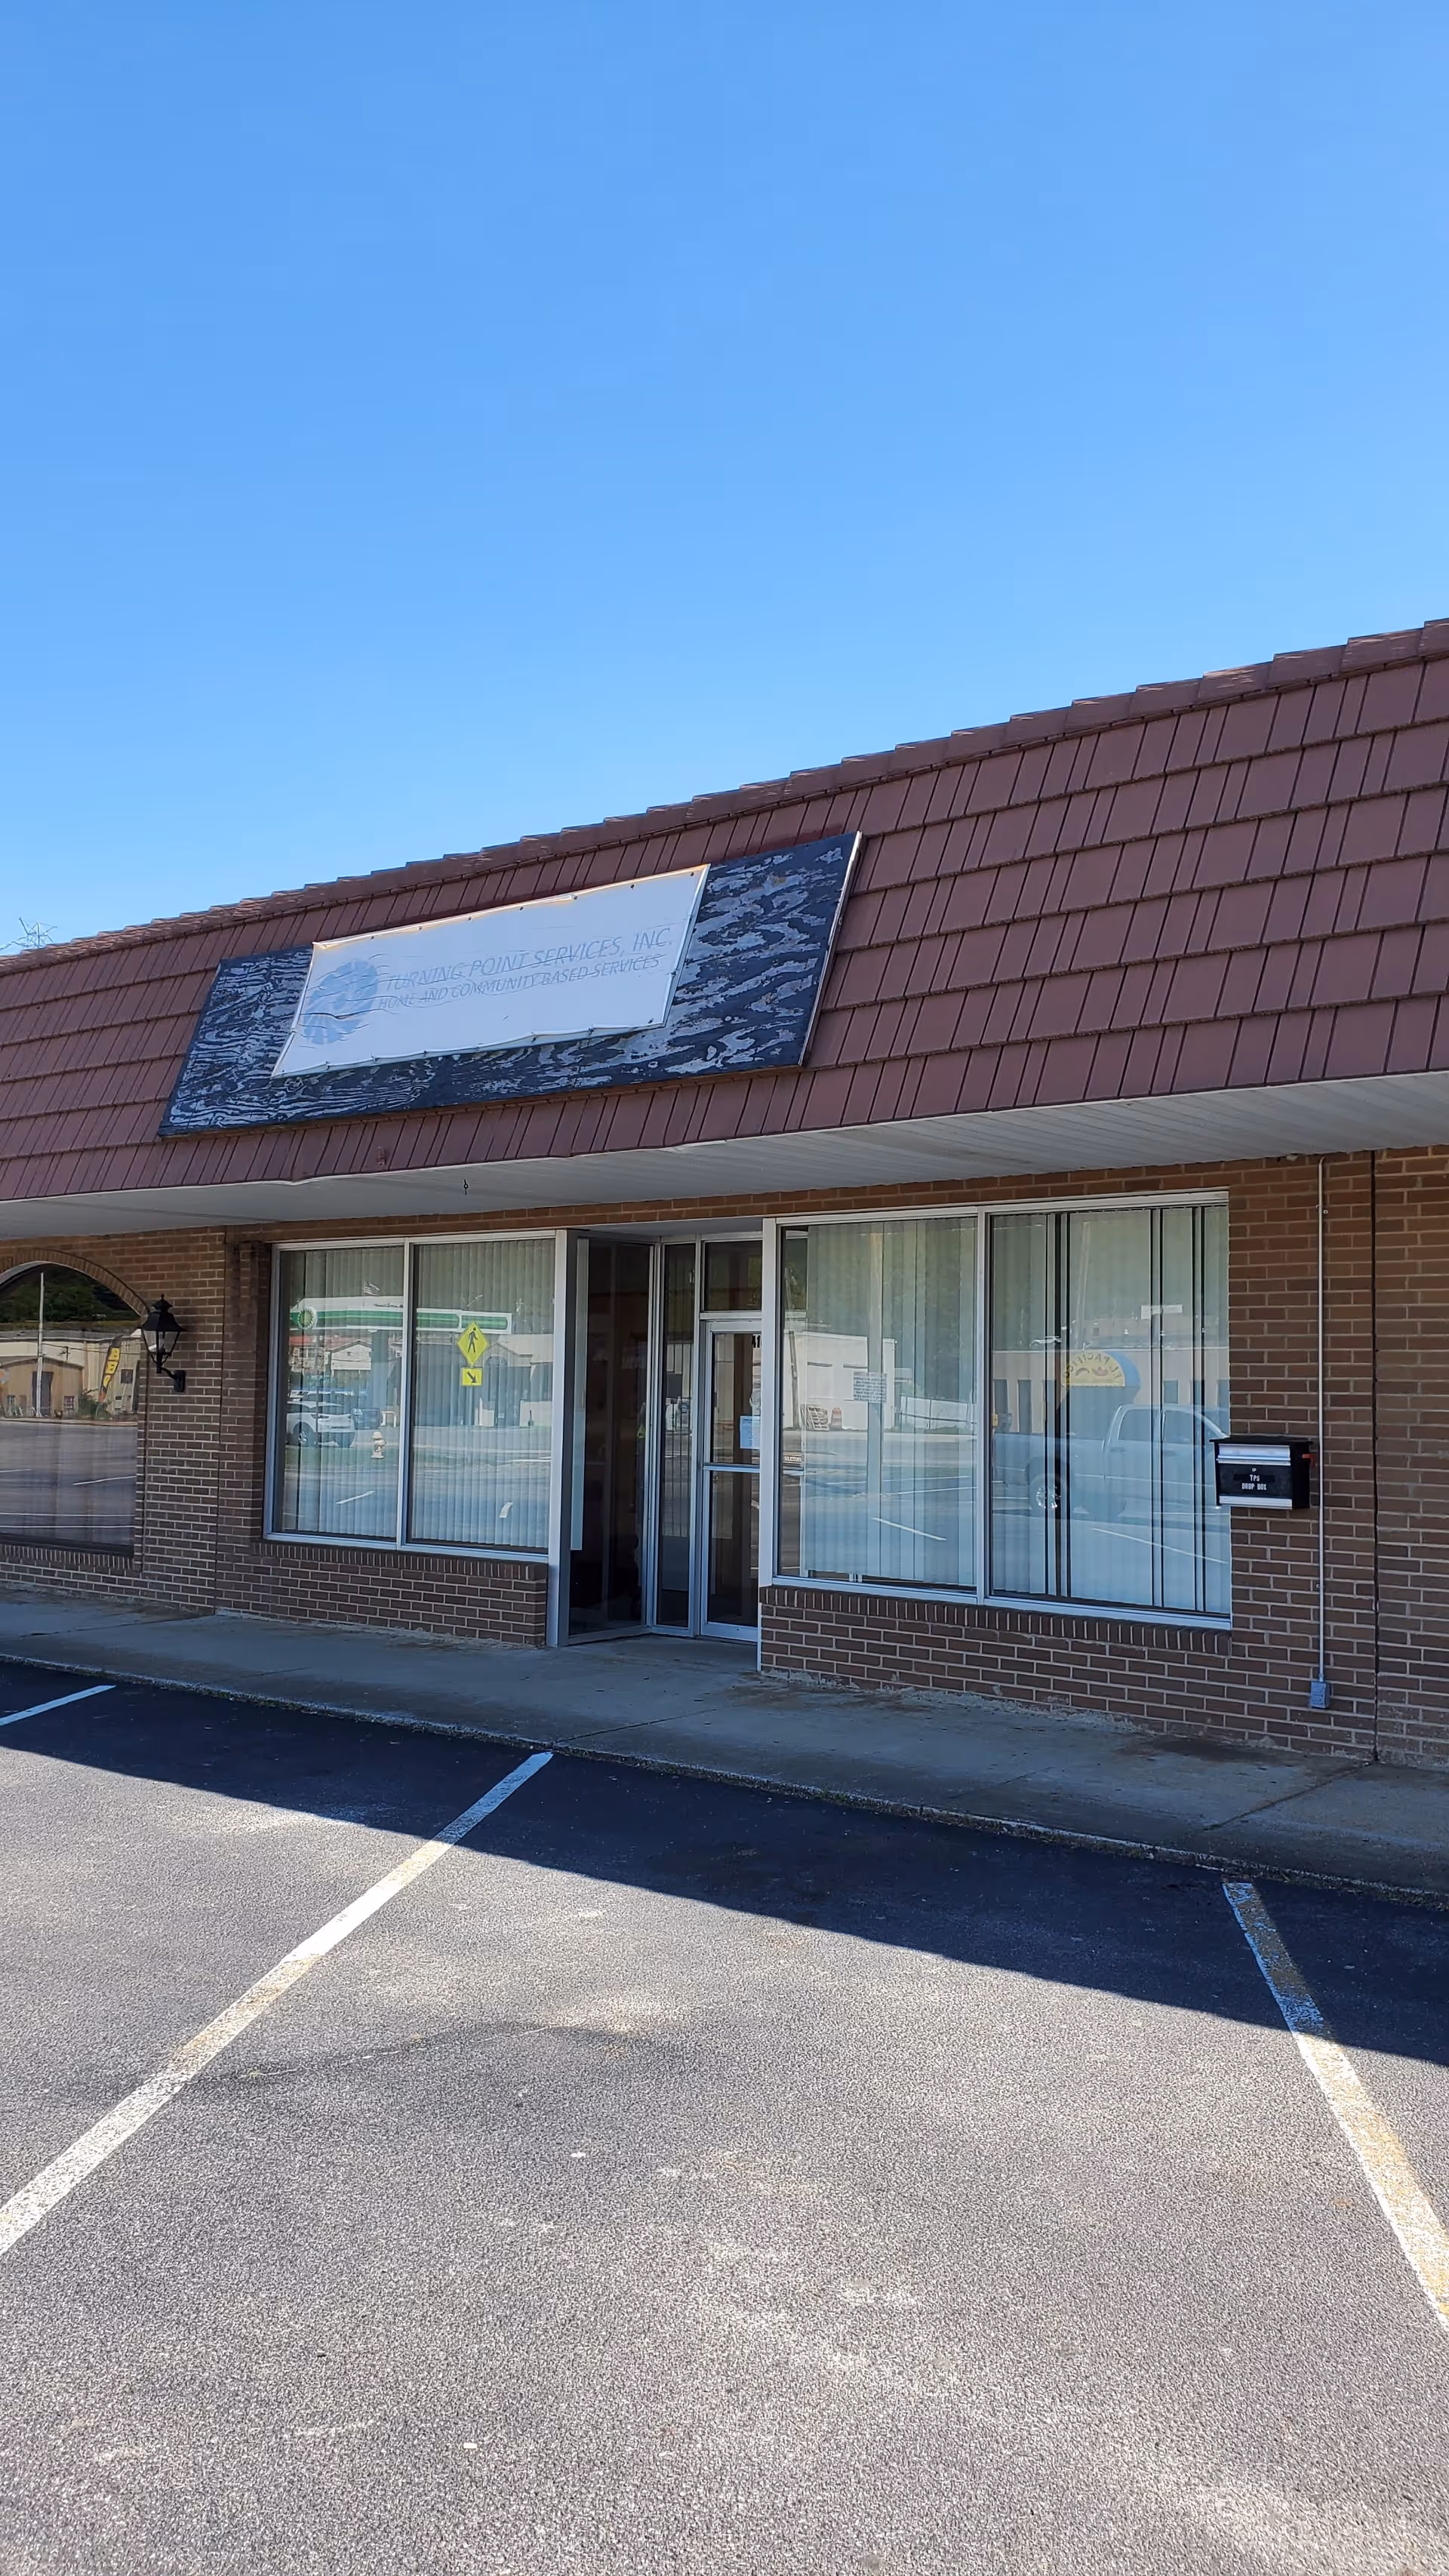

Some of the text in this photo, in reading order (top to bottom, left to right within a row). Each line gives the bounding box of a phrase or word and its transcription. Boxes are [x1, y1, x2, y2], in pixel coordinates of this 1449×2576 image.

[378, 956, 660, 1009] HOME AND COMMUNITY BASED SERVICES
[386, 928, 672, 990] TURNING POINT SERVICES, INC.
